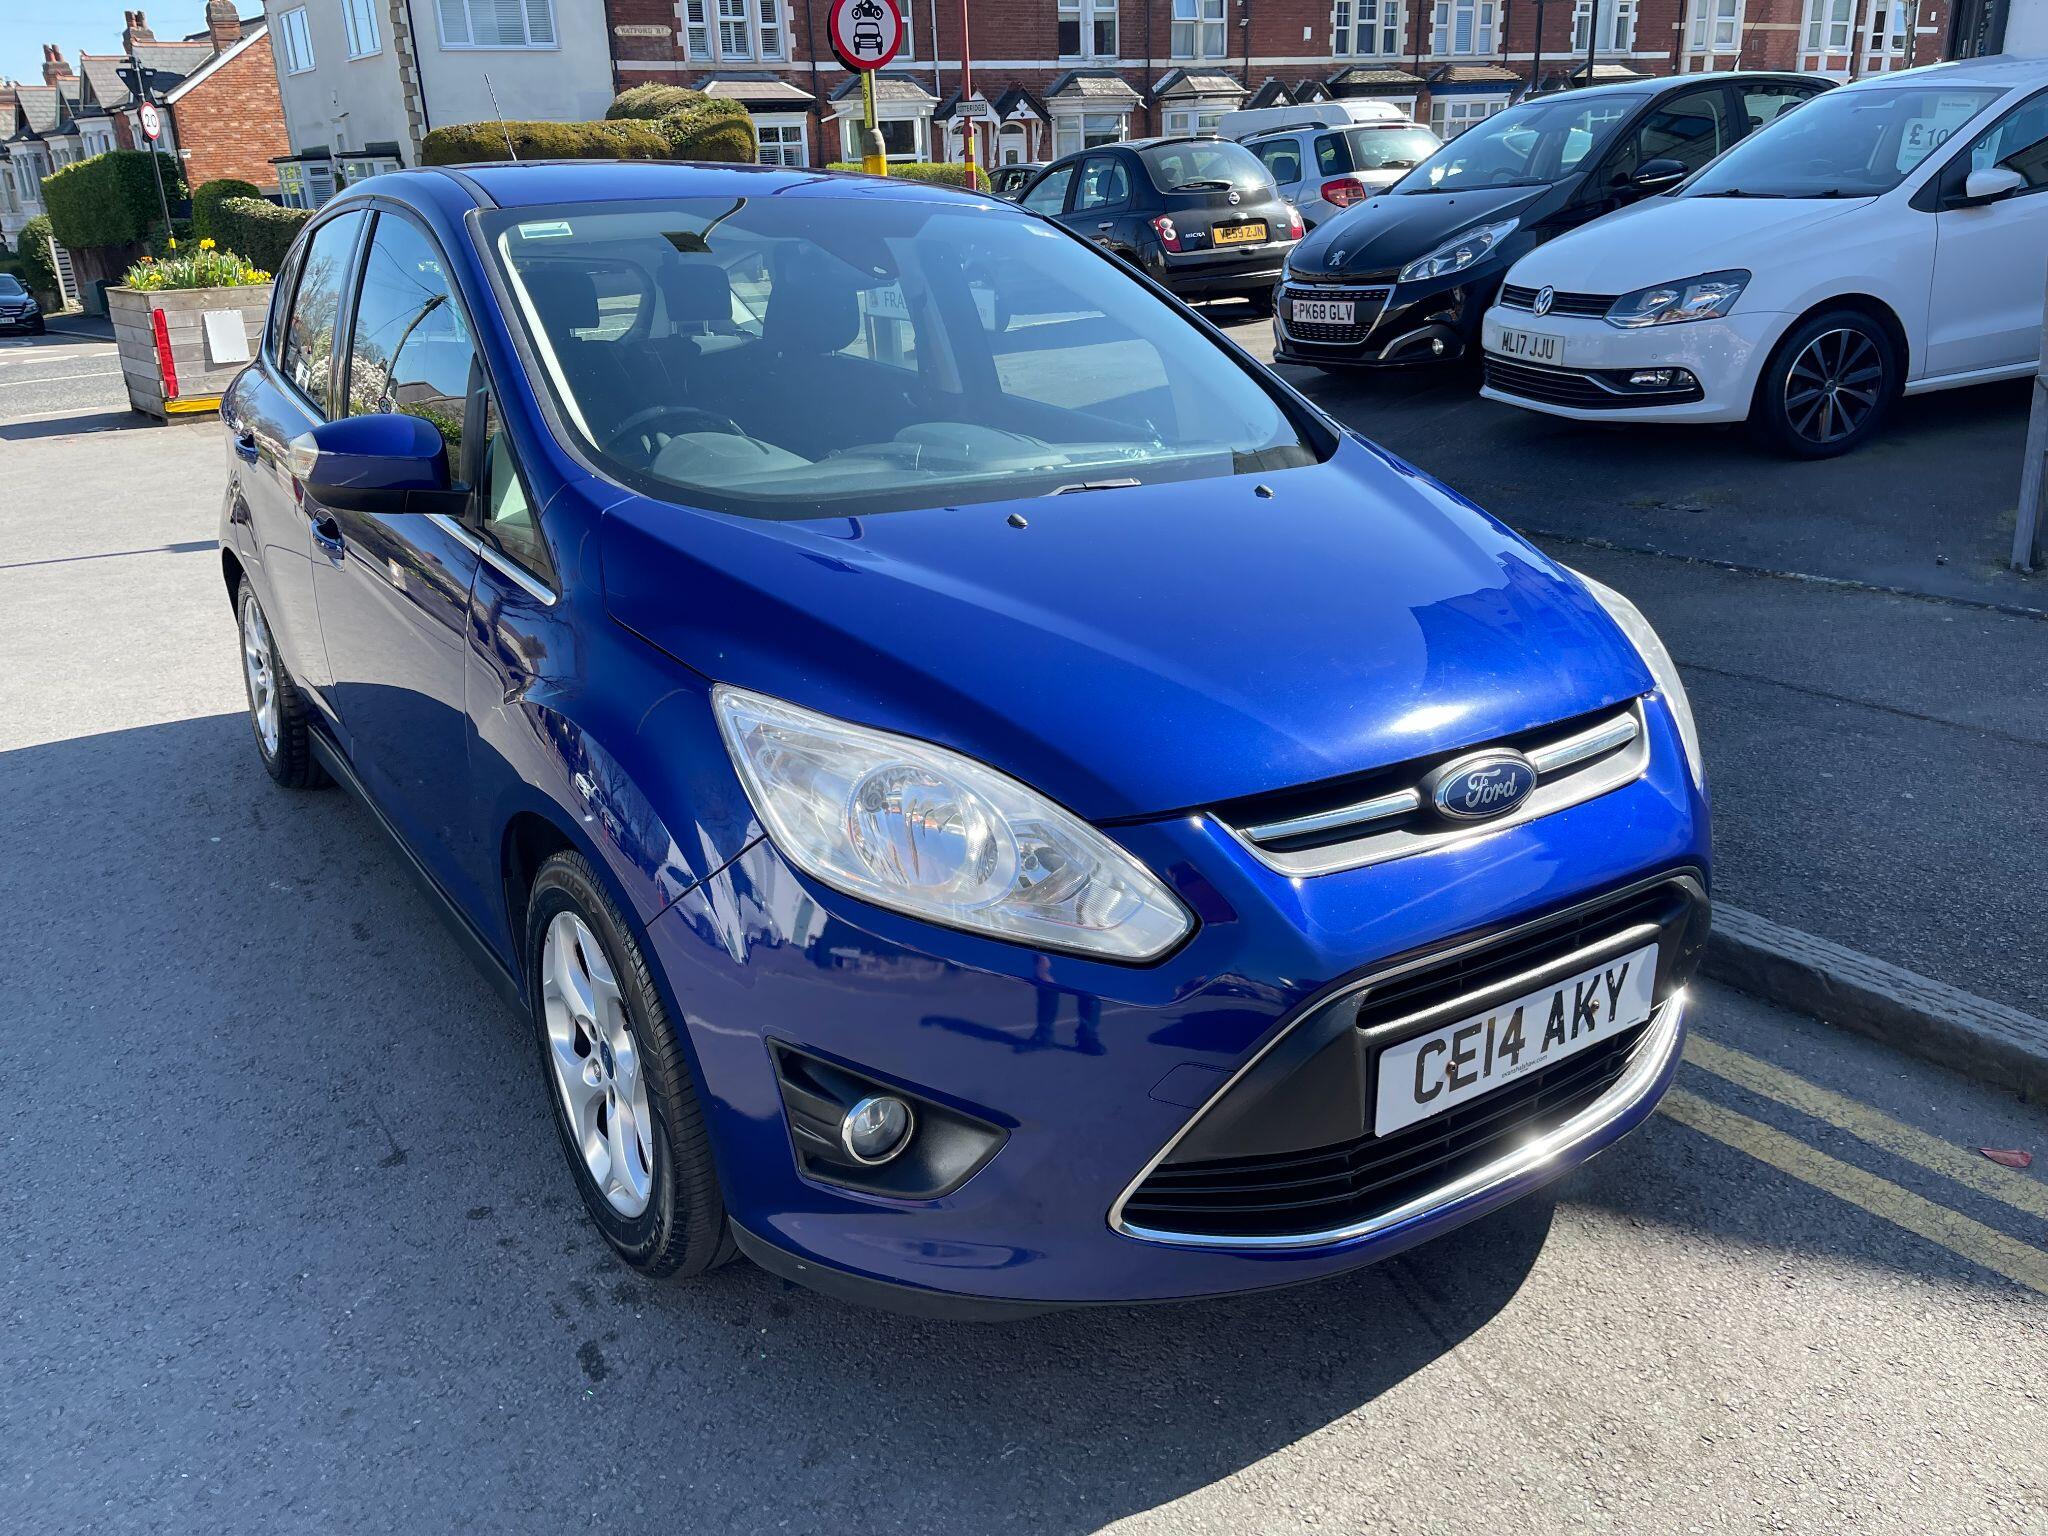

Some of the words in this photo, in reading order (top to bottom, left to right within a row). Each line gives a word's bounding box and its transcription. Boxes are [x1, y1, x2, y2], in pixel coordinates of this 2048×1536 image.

[957, 103, 985, 113] COTTERIDGE
[144, 113, 157, 128] 20
[1299, 302, 1326, 320] PK68
[1329, 304, 1353, 321] GLV
[1501, 331, 1527, 355] ML17
[1529, 337, 1555, 359] JJU
[1465, 768, 1518, 808] Ford
[1413, 1005, 1526, 1104] CE14
[1540, 961, 1630, 1053] AKY
